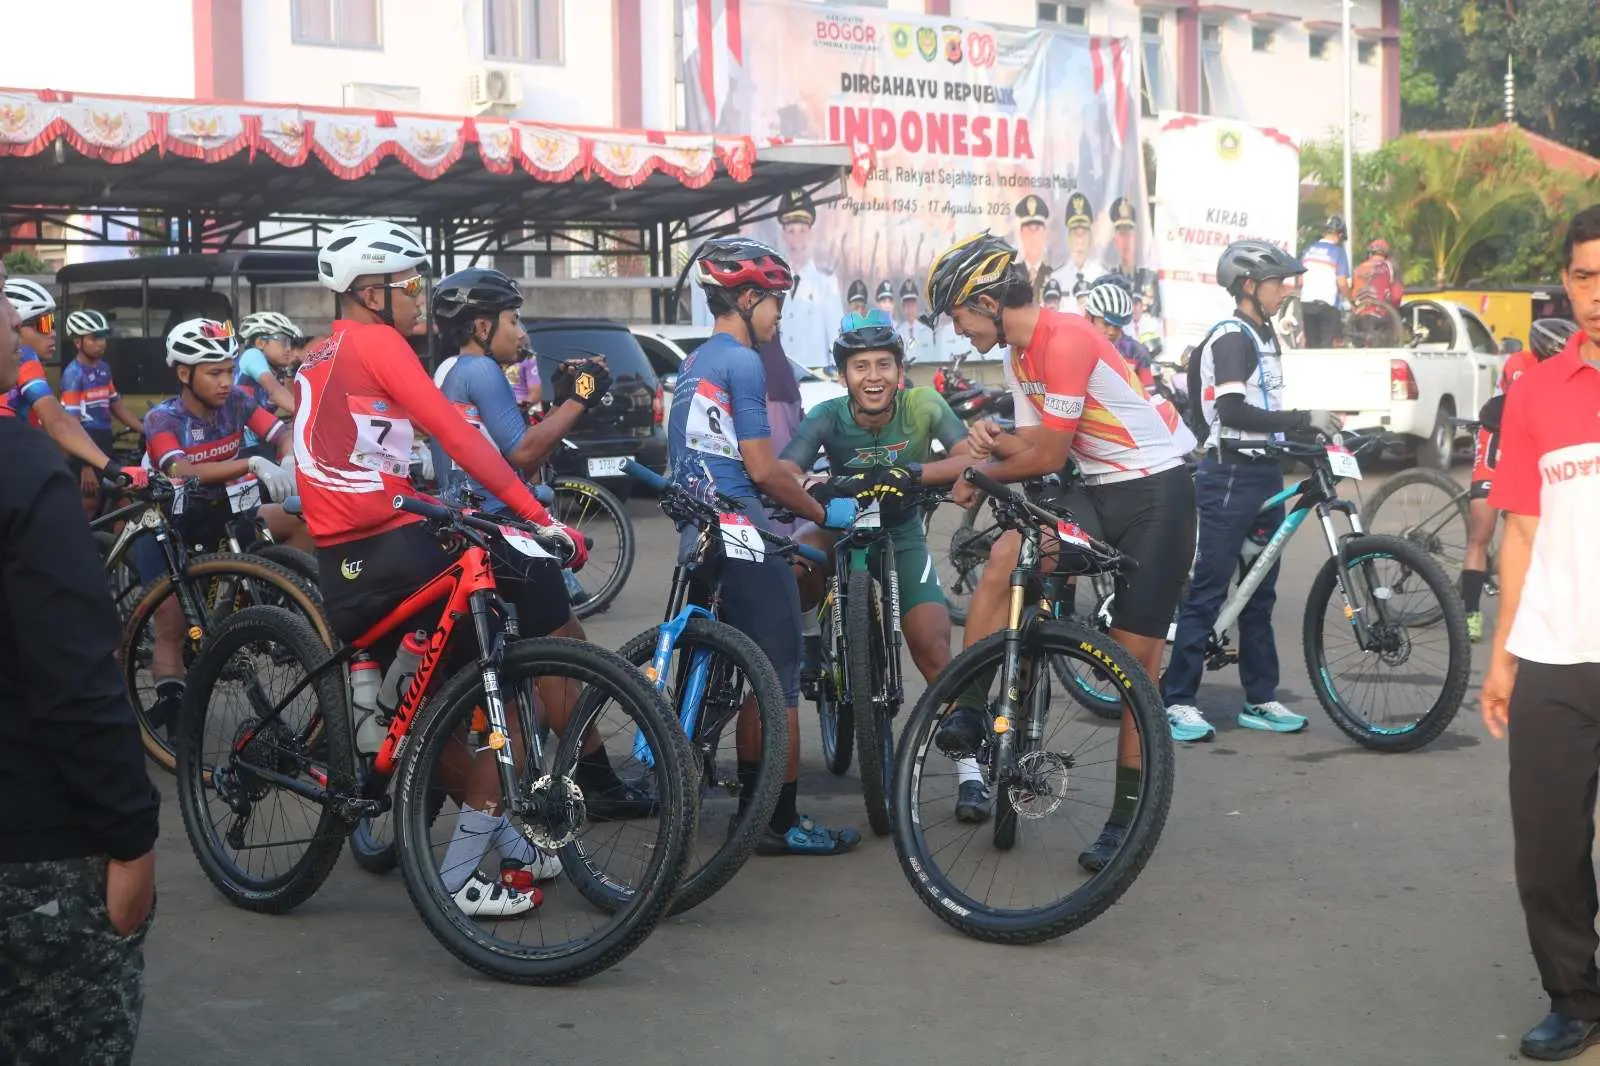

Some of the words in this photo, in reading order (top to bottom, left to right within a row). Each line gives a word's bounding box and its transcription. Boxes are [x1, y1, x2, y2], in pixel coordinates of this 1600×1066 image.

[816, 20, 876, 43] BOGOR
[841, 72, 938, 100] DIRGAHAYU
[828, 105, 1035, 160] INDONESIA
[896, 166, 935, 187] Rakyat
[996, 170, 1051, 189] Indonesia
[1053, 172, 1078, 192] Maju
[842, 196, 890, 216] Agustus
[892, 199, 918, 213] 1945
[928, 199, 940, 213] 17
[941, 199, 983, 218] Agustus
[1206, 207, 1249, 228] KIRAB
[370, 419, 393, 446] 7
[706, 405, 723, 435] 6
[741, 529, 749, 542] 6
[1080, 641, 1132, 689] MAXXIS
[402, 735, 425, 803] PIRELLI
